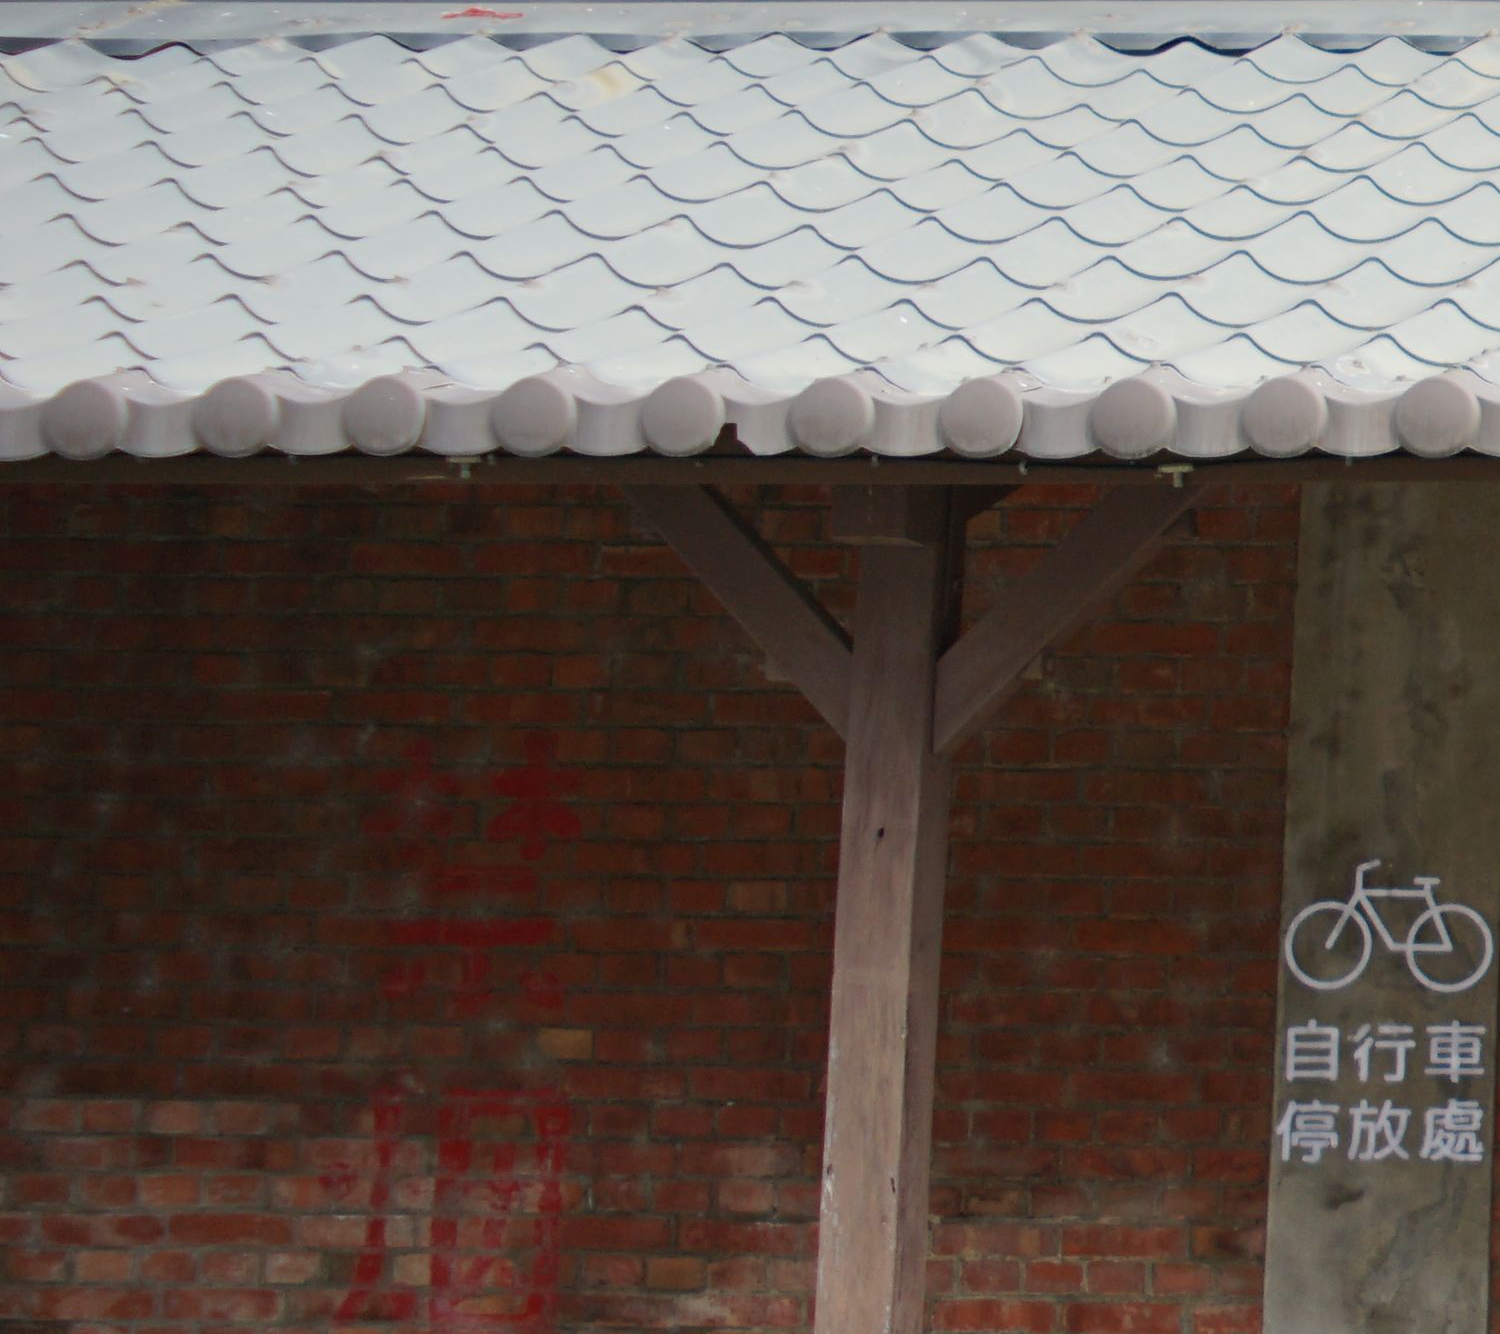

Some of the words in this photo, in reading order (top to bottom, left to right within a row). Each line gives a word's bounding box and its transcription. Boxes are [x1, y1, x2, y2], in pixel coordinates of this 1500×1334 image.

[1285, 1019, 1487, 1083] 自行車
[1276, 1098, 1484, 1163] 停放處
